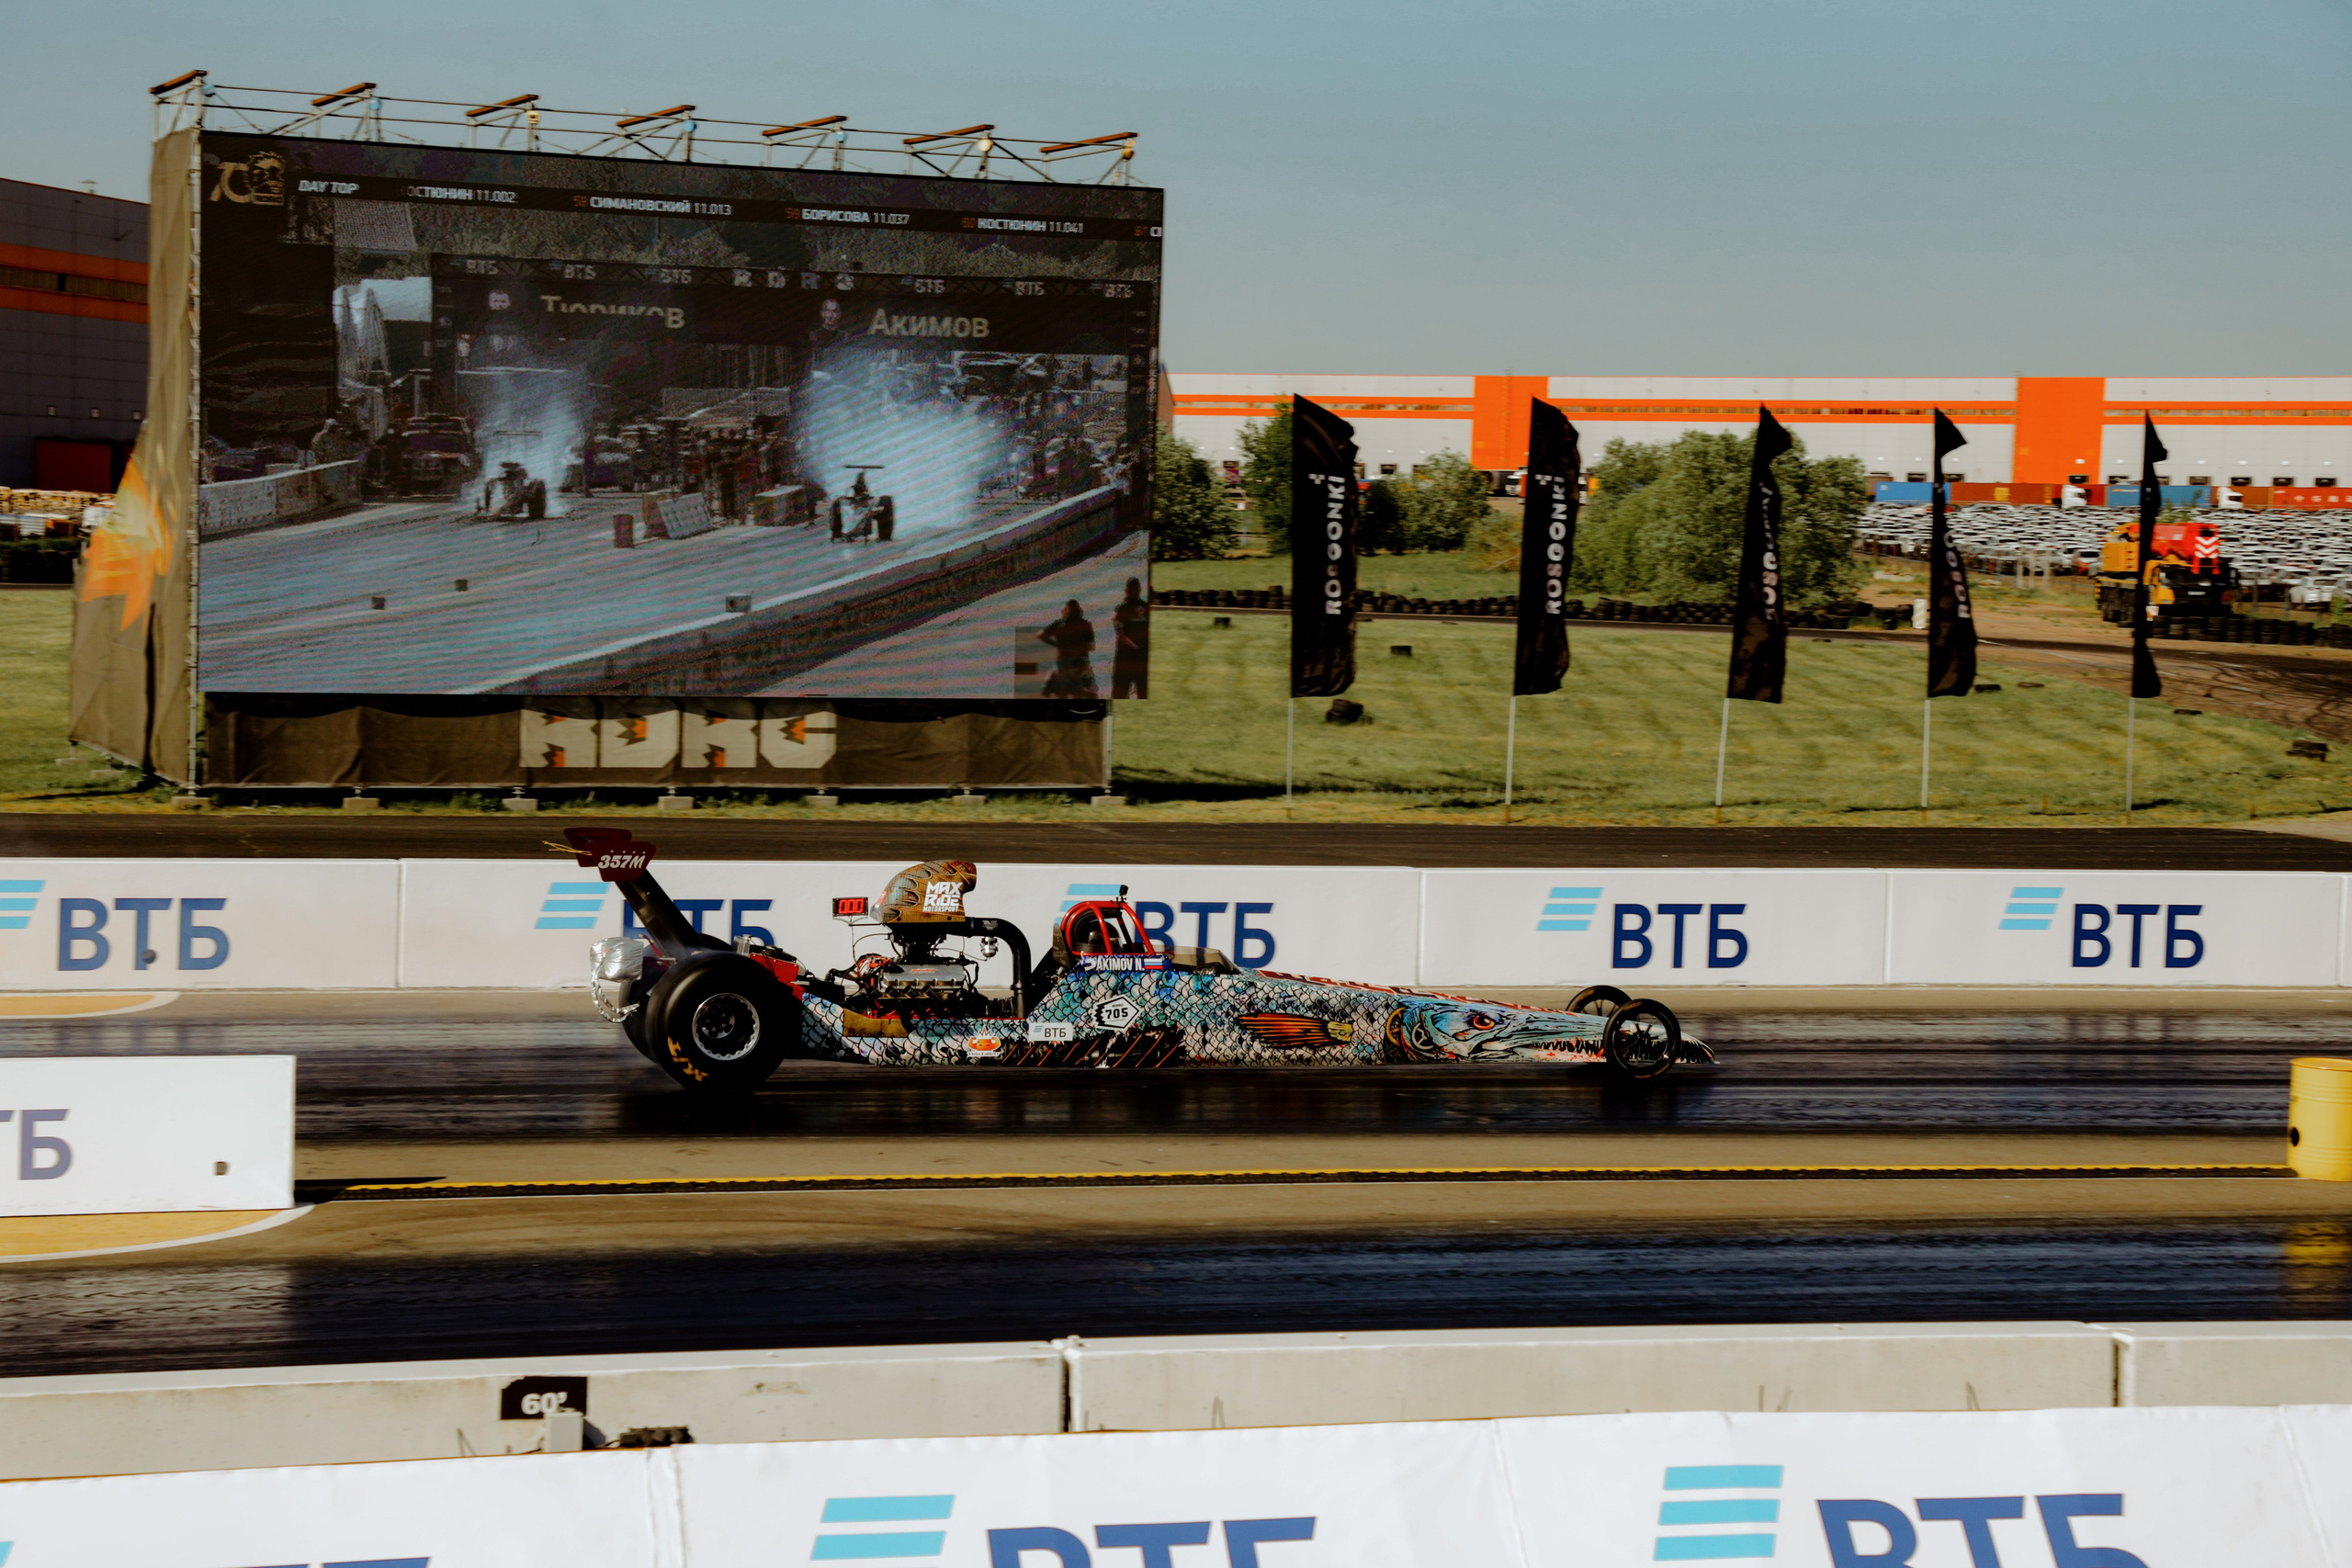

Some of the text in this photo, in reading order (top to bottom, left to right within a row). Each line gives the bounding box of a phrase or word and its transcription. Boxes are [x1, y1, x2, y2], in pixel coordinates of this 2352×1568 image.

[298, 179, 359, 195] DAY TOP
[589, 196, 691, 213] СИМАНОВСКИЙ
[694, 202, 732, 216] 11.013
[801, 208, 870, 223] БОРИСОВА
[873, 211, 911, 225] 11.037
[977, 217, 1047, 231] КОСТЮНИН
[1544, 476, 1568, 615] ROSGONKI
[597, 854, 647, 870] 357M
[925, 881, 964, 895] MAX
[57, 897, 230, 971] ВТБ
[1134, 900, 1276, 969] ВТБ
[1611, 903, 1749, 970] ВТБ
[2072, 903, 2205, 968] ВТБ
[1096, 956, 1133, 971] AKIMOV
[1105, 1007, 1128, 1020] 705
[1044, 1027, 1067, 1038] ВТБ
